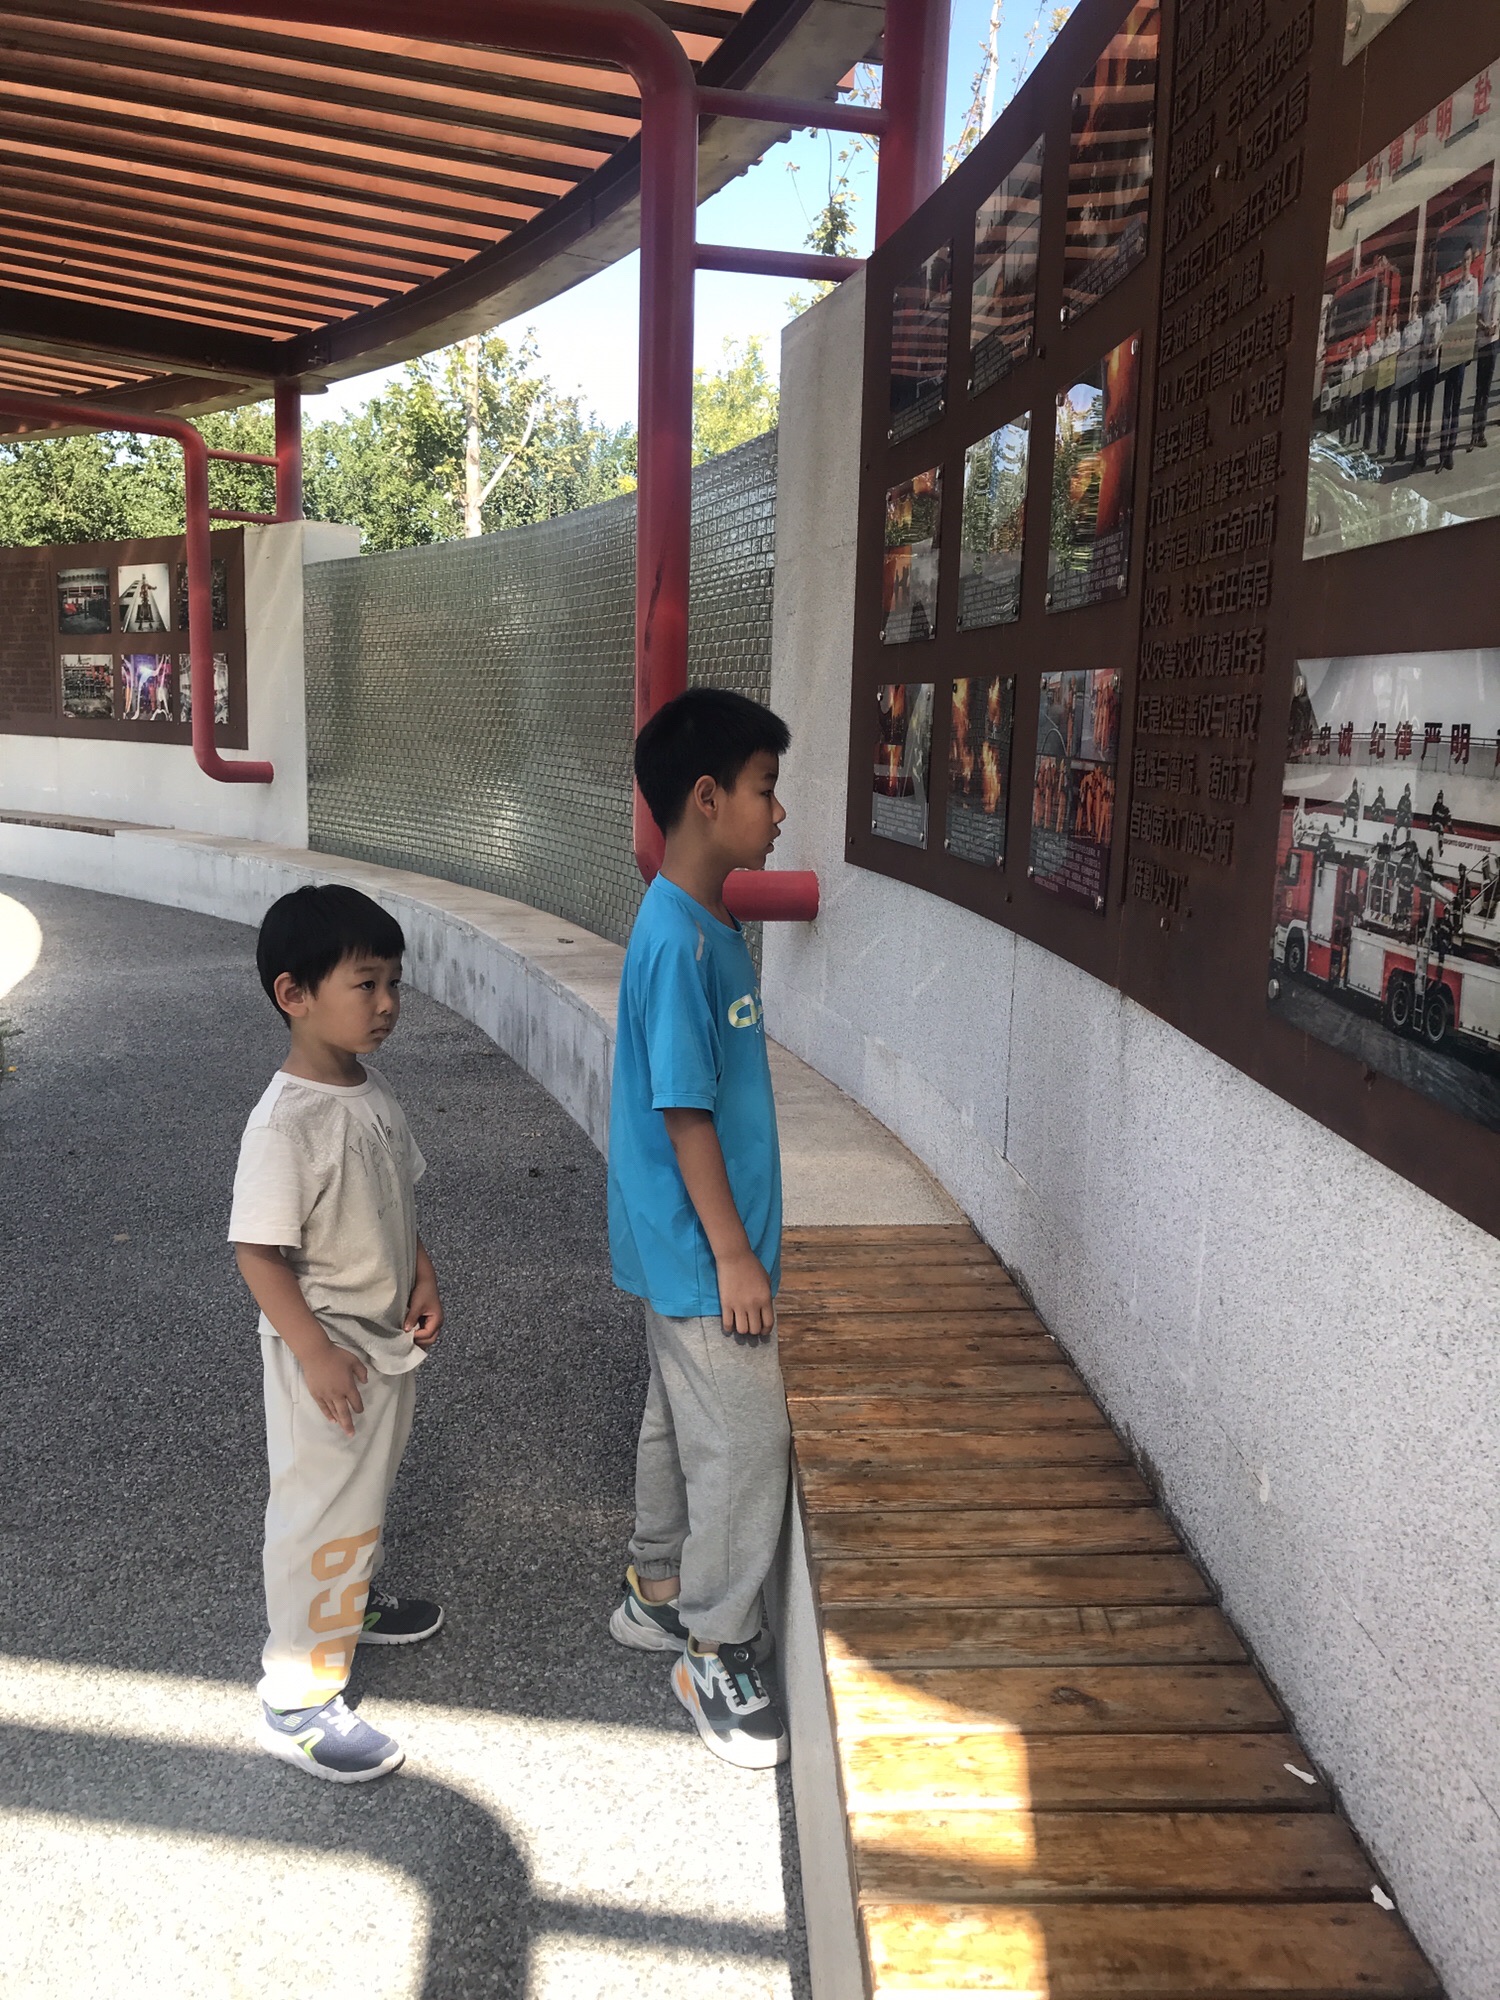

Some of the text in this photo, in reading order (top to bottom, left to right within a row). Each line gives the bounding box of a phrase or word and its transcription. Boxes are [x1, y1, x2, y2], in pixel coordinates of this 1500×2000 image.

[1139, 628, 1263, 679] 火灾等灭火救援任务
[1136, 694, 1257, 741] 正是这些恶仗与硬仗
[1369, 721, 1471, 765] 纪律严明
[1130, 800, 1230, 864] 首都南大门的这柄
